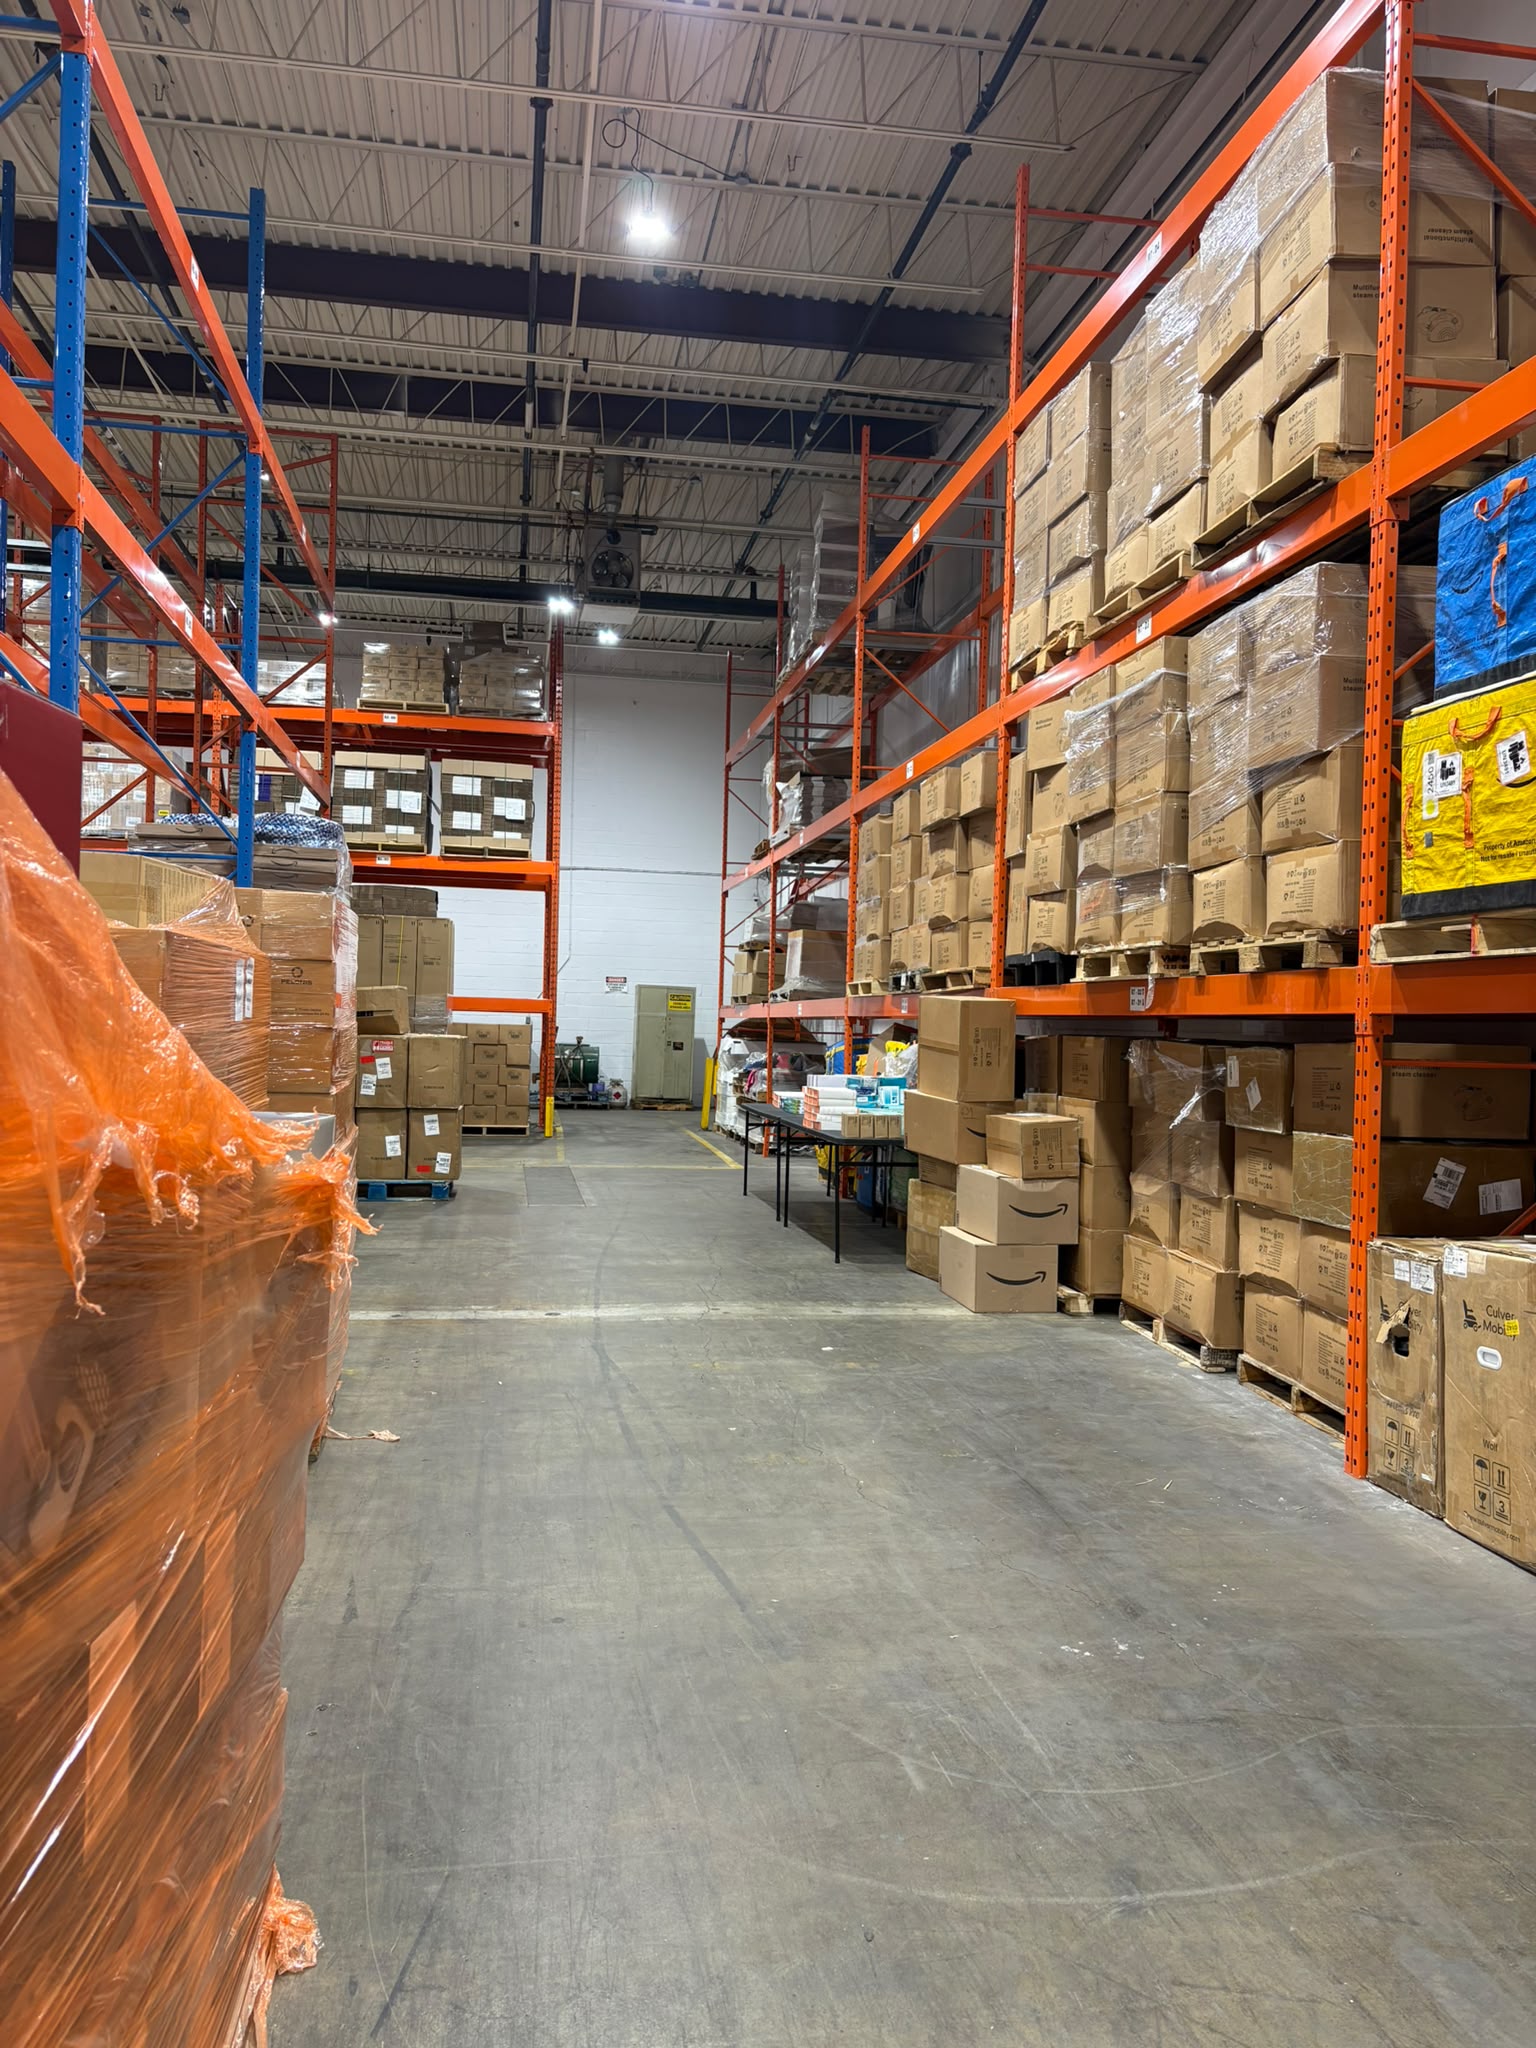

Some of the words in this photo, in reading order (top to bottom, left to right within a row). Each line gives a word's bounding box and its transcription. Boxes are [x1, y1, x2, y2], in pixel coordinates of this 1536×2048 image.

[1485, 1304, 1515, 1321] Culver
[1482, 1437, 1498, 1452] Wolf
[1498, 1501, 1505, 1513] 3
